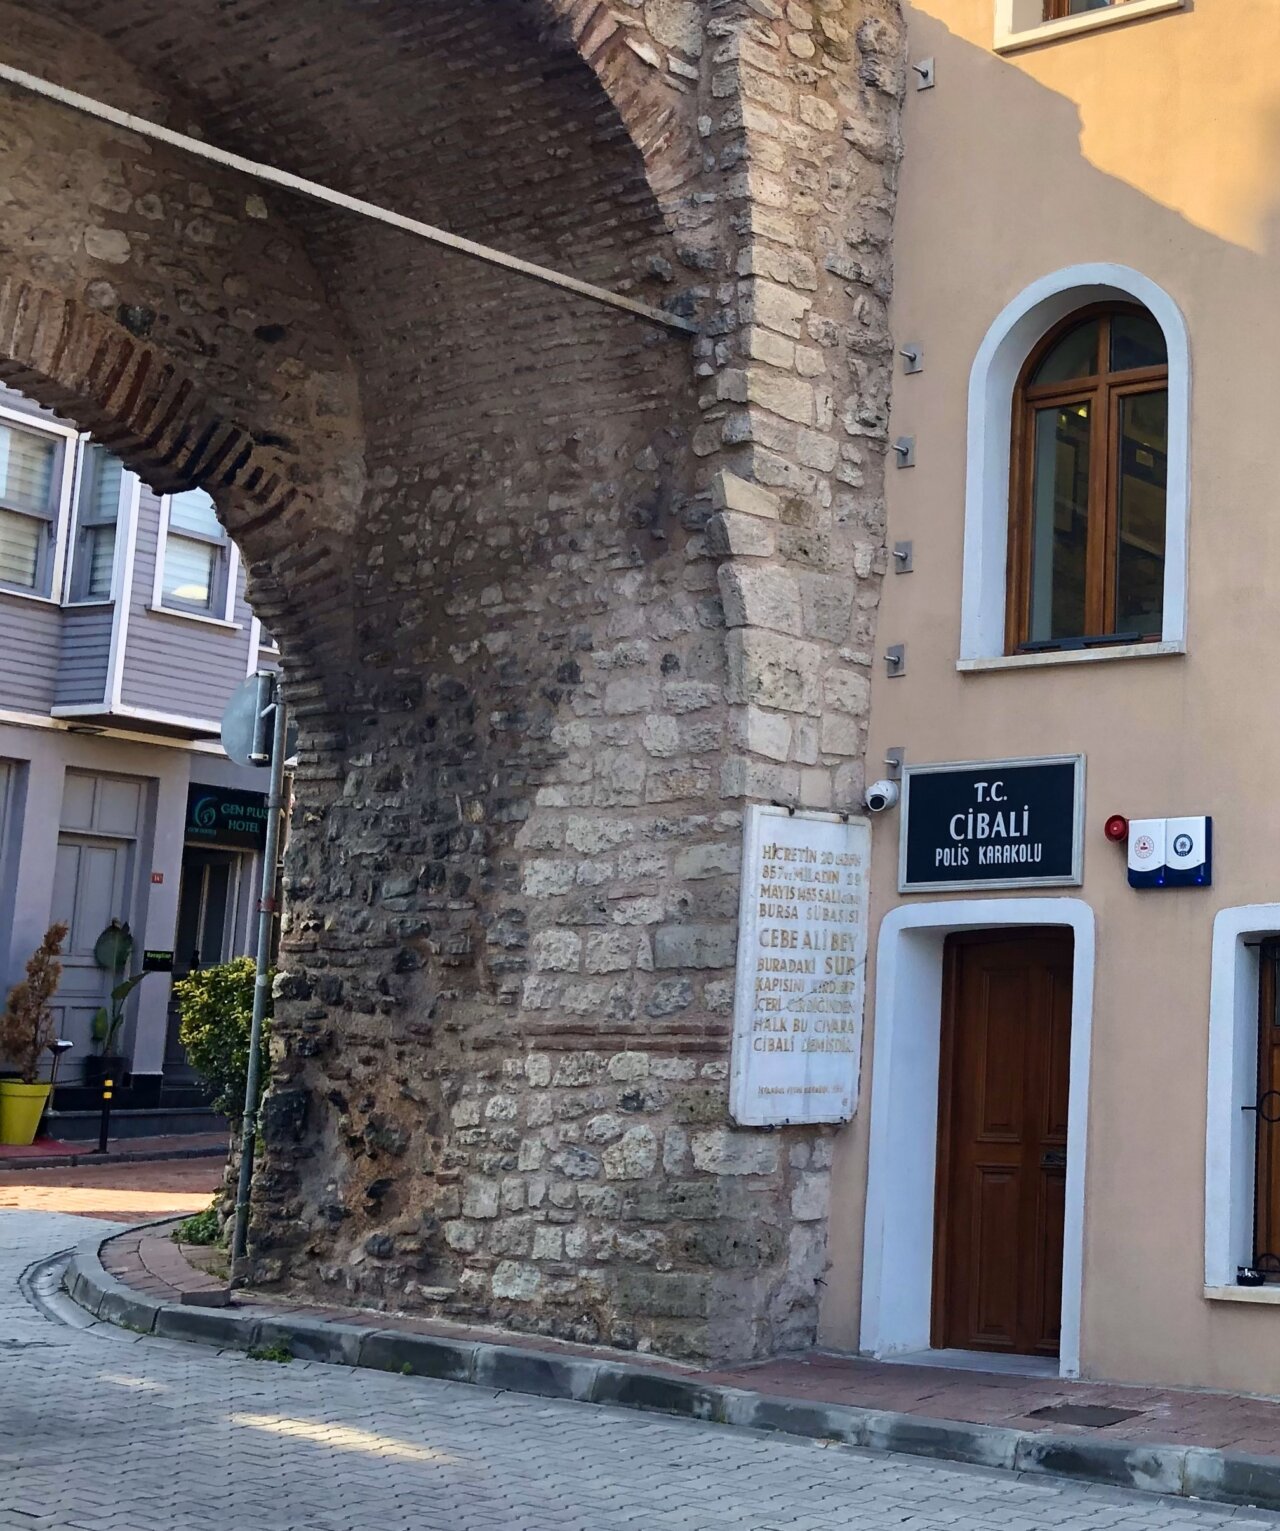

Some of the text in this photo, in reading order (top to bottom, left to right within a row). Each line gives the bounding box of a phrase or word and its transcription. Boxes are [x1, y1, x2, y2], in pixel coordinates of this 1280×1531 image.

[974, 781, 1008, 802] T.C.
[220, 803, 244, 815] GEN
[228, 820, 259, 833] HOTEL
[949, 804, 1029, 840] CİBALİ
[935, 843, 1042, 867] POLİS KARAKOLU
[760, 884, 795, 900] MAYIS
[759, 903, 798, 919] BURSA
[758, 928, 798, 949] CEBE
[831, 932, 857, 952] BEY
[756, 956, 856, 976] BURADAKİ SUR
[755, 976, 805, 993] KAPISINI
[753, 1018, 787, 1032] HALK
[793, 1018, 808, 1033] BU
[753, 1035, 795, 1052] CİBALİ
